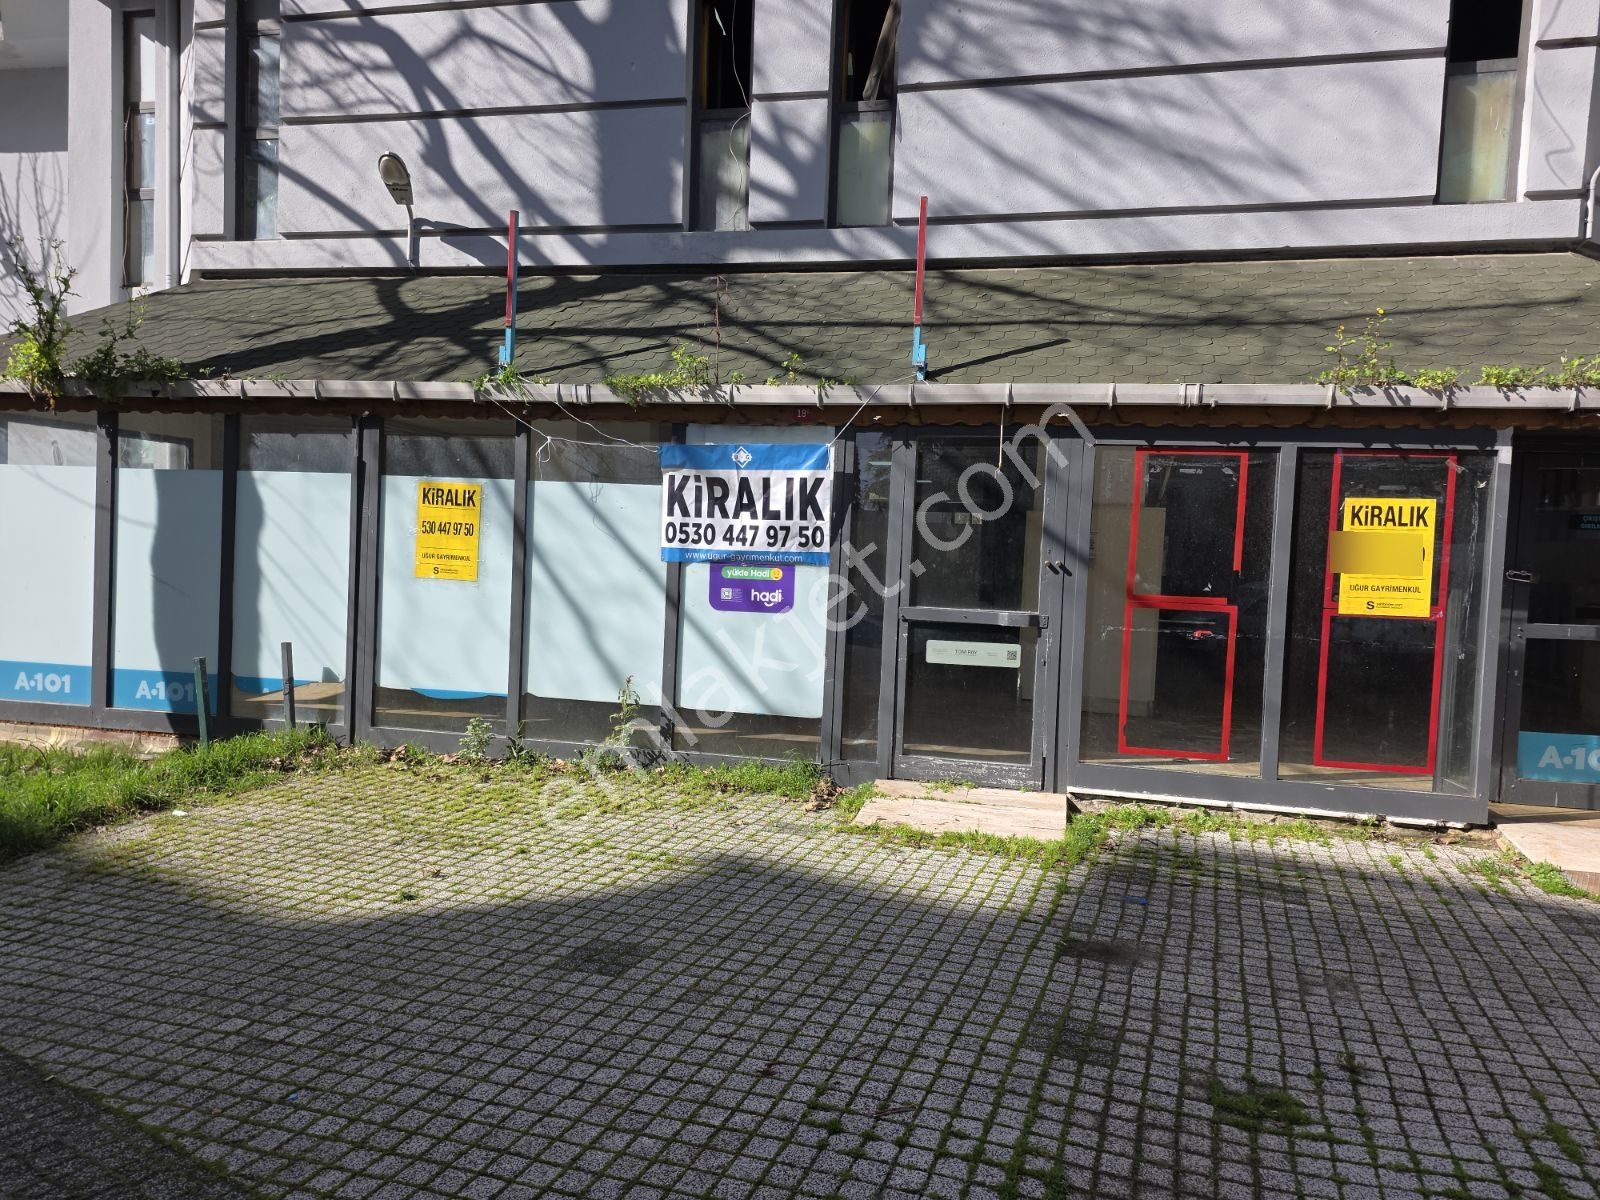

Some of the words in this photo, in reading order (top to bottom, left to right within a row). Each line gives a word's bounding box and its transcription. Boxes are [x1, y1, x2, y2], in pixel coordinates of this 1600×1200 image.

[421, 520, 436, 535] 530
[437, 521, 451, 536] 447
[453, 522, 462, 536] 97
[463, 523, 474, 537] 50
[665, 522, 716, 545] 0530
[723, 524, 759, 547] 447
[766, 526, 791, 547] 97
[798, 526, 825, 548] 50
[750, 569, 770, 578] Hadi
[1349, 583, 1369, 592] UĞUR
[751, 588, 783, 606] hadi
